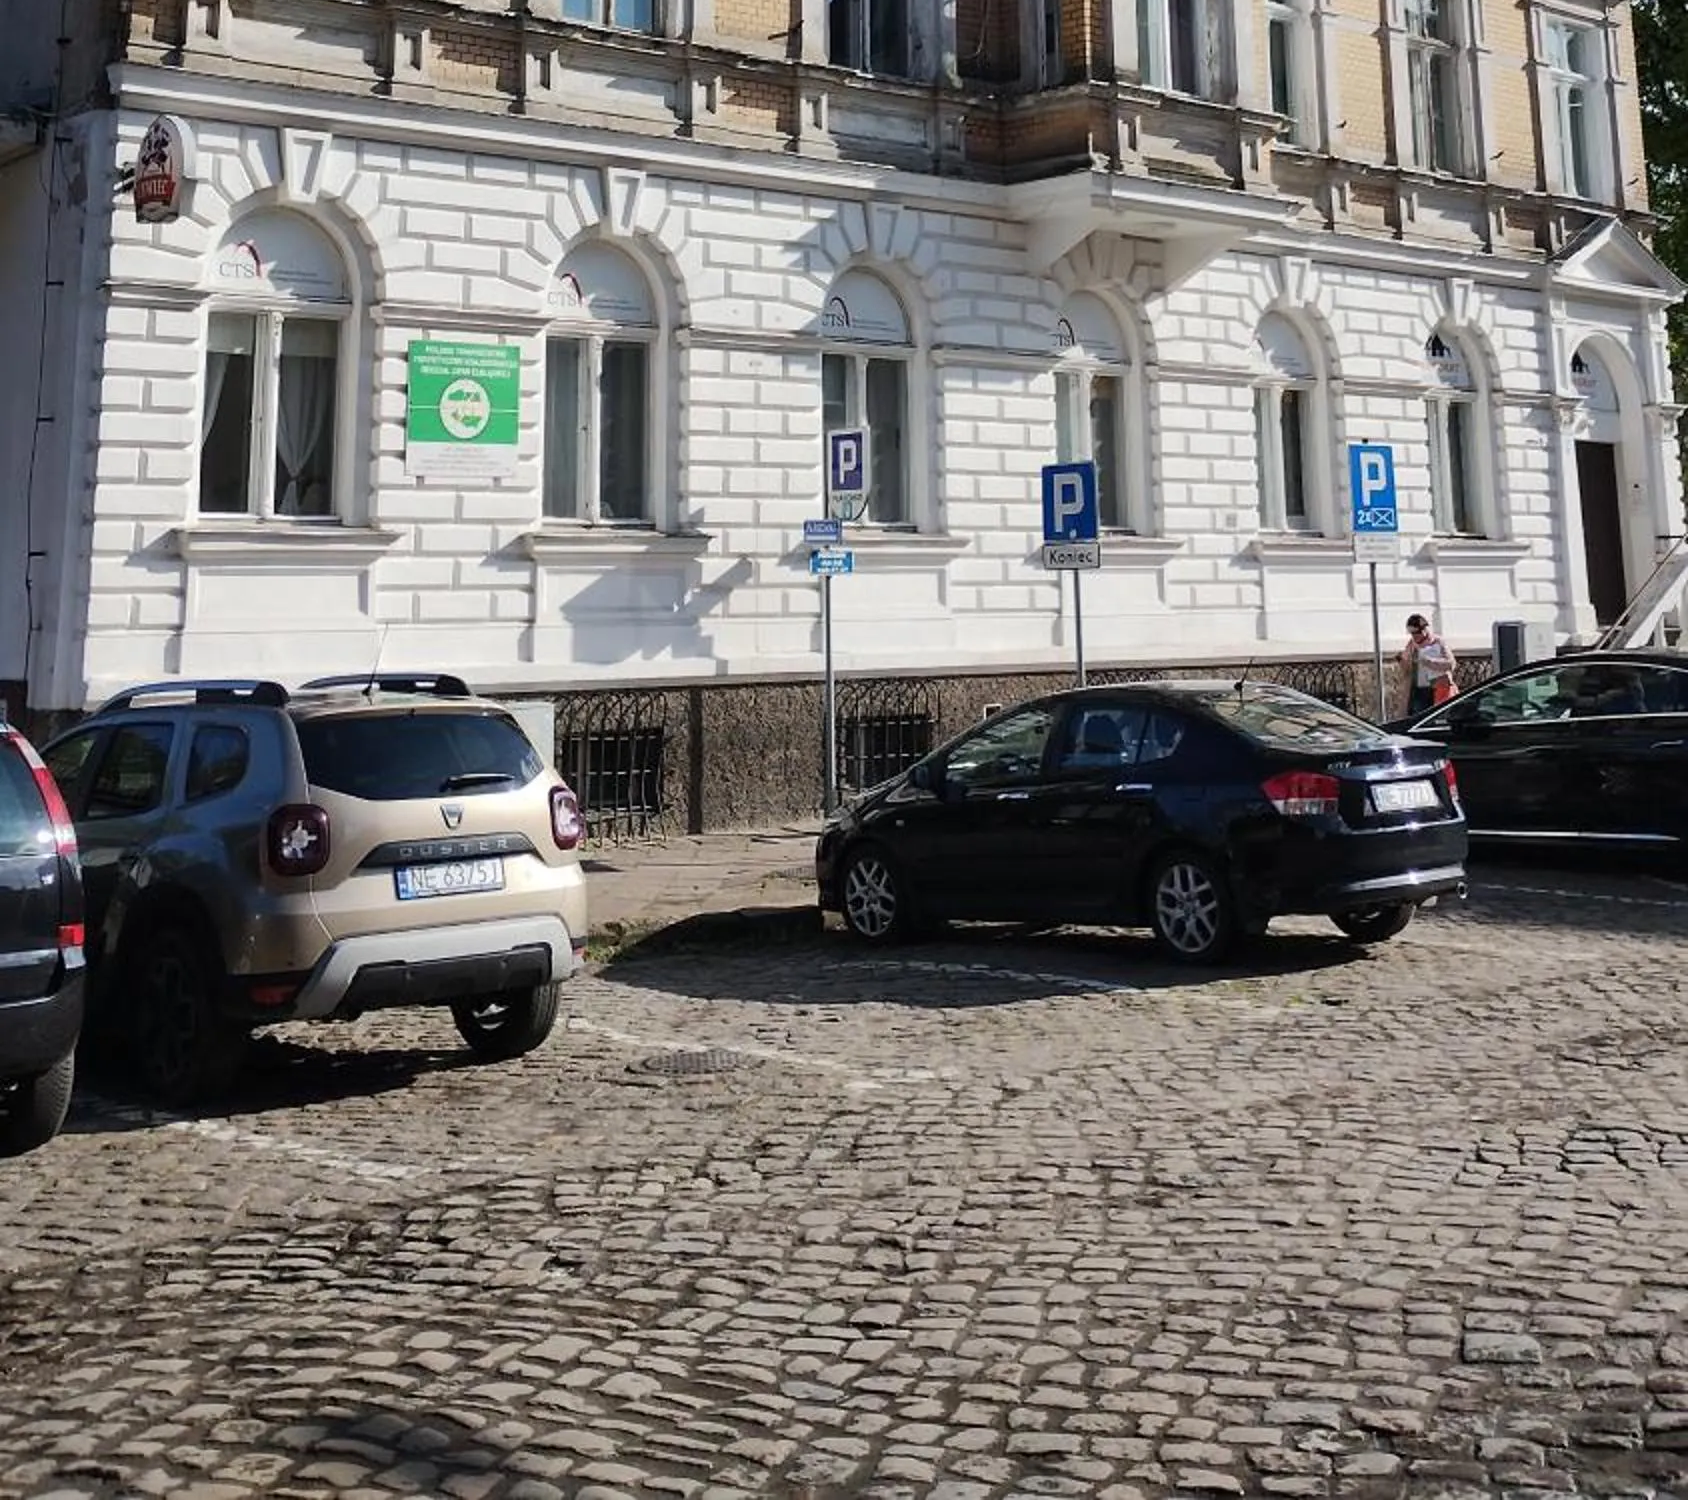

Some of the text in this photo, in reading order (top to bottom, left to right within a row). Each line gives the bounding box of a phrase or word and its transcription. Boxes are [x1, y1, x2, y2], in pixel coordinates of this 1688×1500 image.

[219, 262, 254, 278] CTS
[839, 439, 857, 485] P
[1360, 451, 1387, 507] P
[1053, 472, 1085, 533] P
[1049, 548, 1093, 565] Koniec
[400, 837, 509, 857] DUSTER
